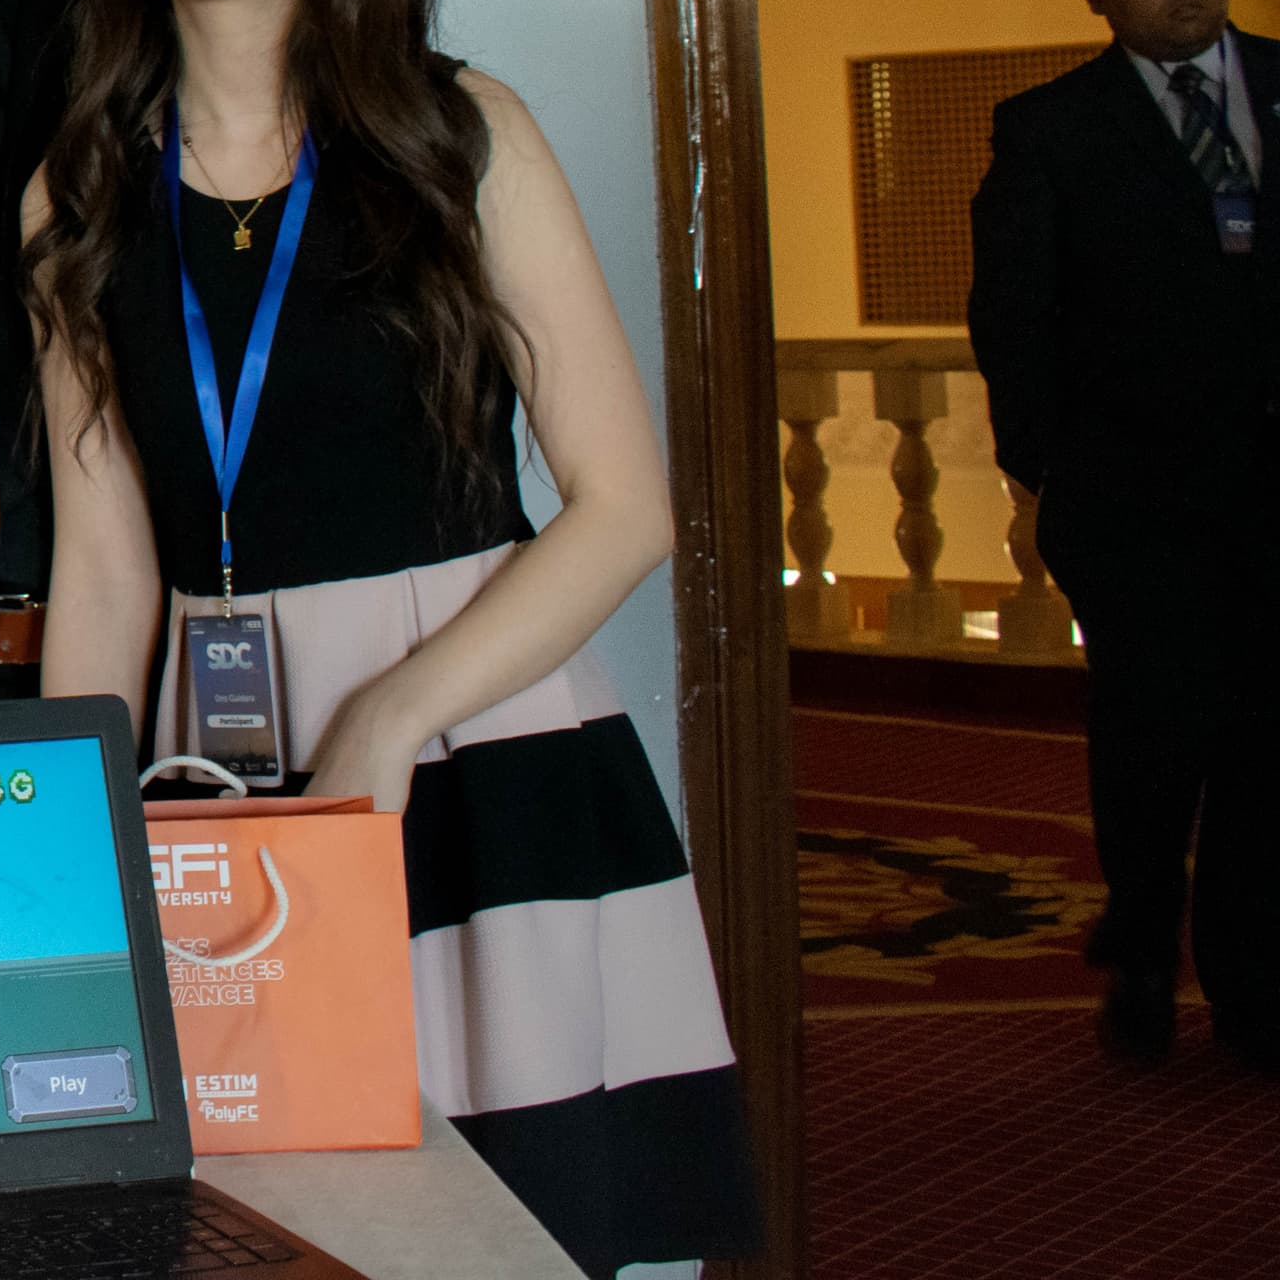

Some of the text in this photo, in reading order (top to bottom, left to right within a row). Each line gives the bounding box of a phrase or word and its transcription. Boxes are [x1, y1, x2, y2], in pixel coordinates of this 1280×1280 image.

[207, 642, 254, 670] SDC
[49, 1075, 87, 1095] Play
[195, 1073, 257, 1091] ESTIM
[205, 1105, 258, 1122] PolyFC
